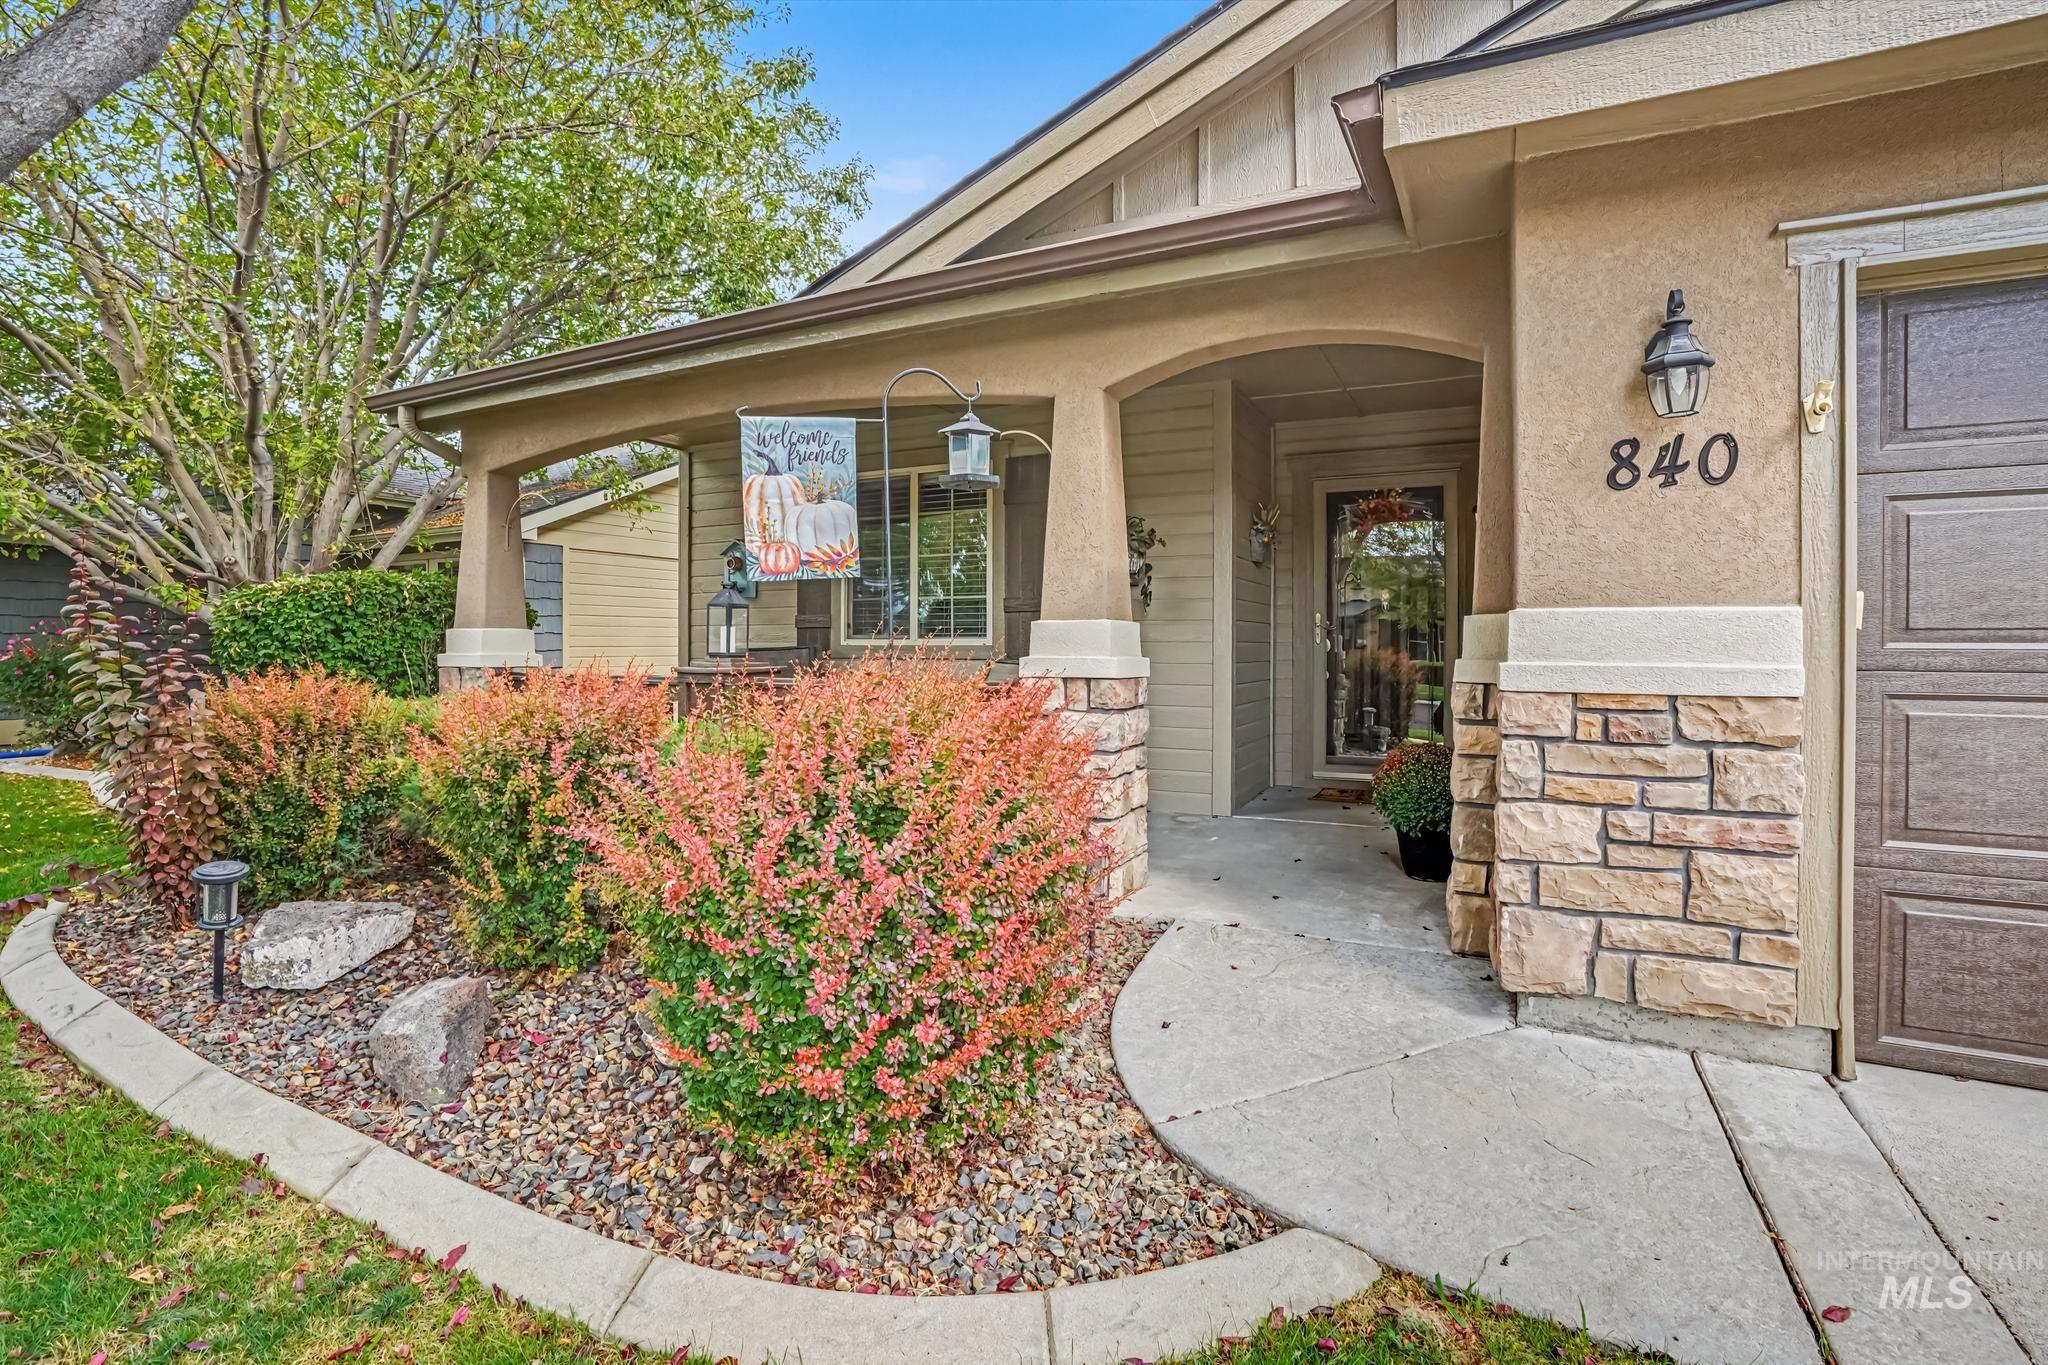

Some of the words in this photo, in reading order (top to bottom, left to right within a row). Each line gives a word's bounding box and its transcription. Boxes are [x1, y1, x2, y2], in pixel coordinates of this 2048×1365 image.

[757, 420, 832, 448] welcome
[788, 437, 849, 471] friends
[1607, 432, 1738, 490] 840
